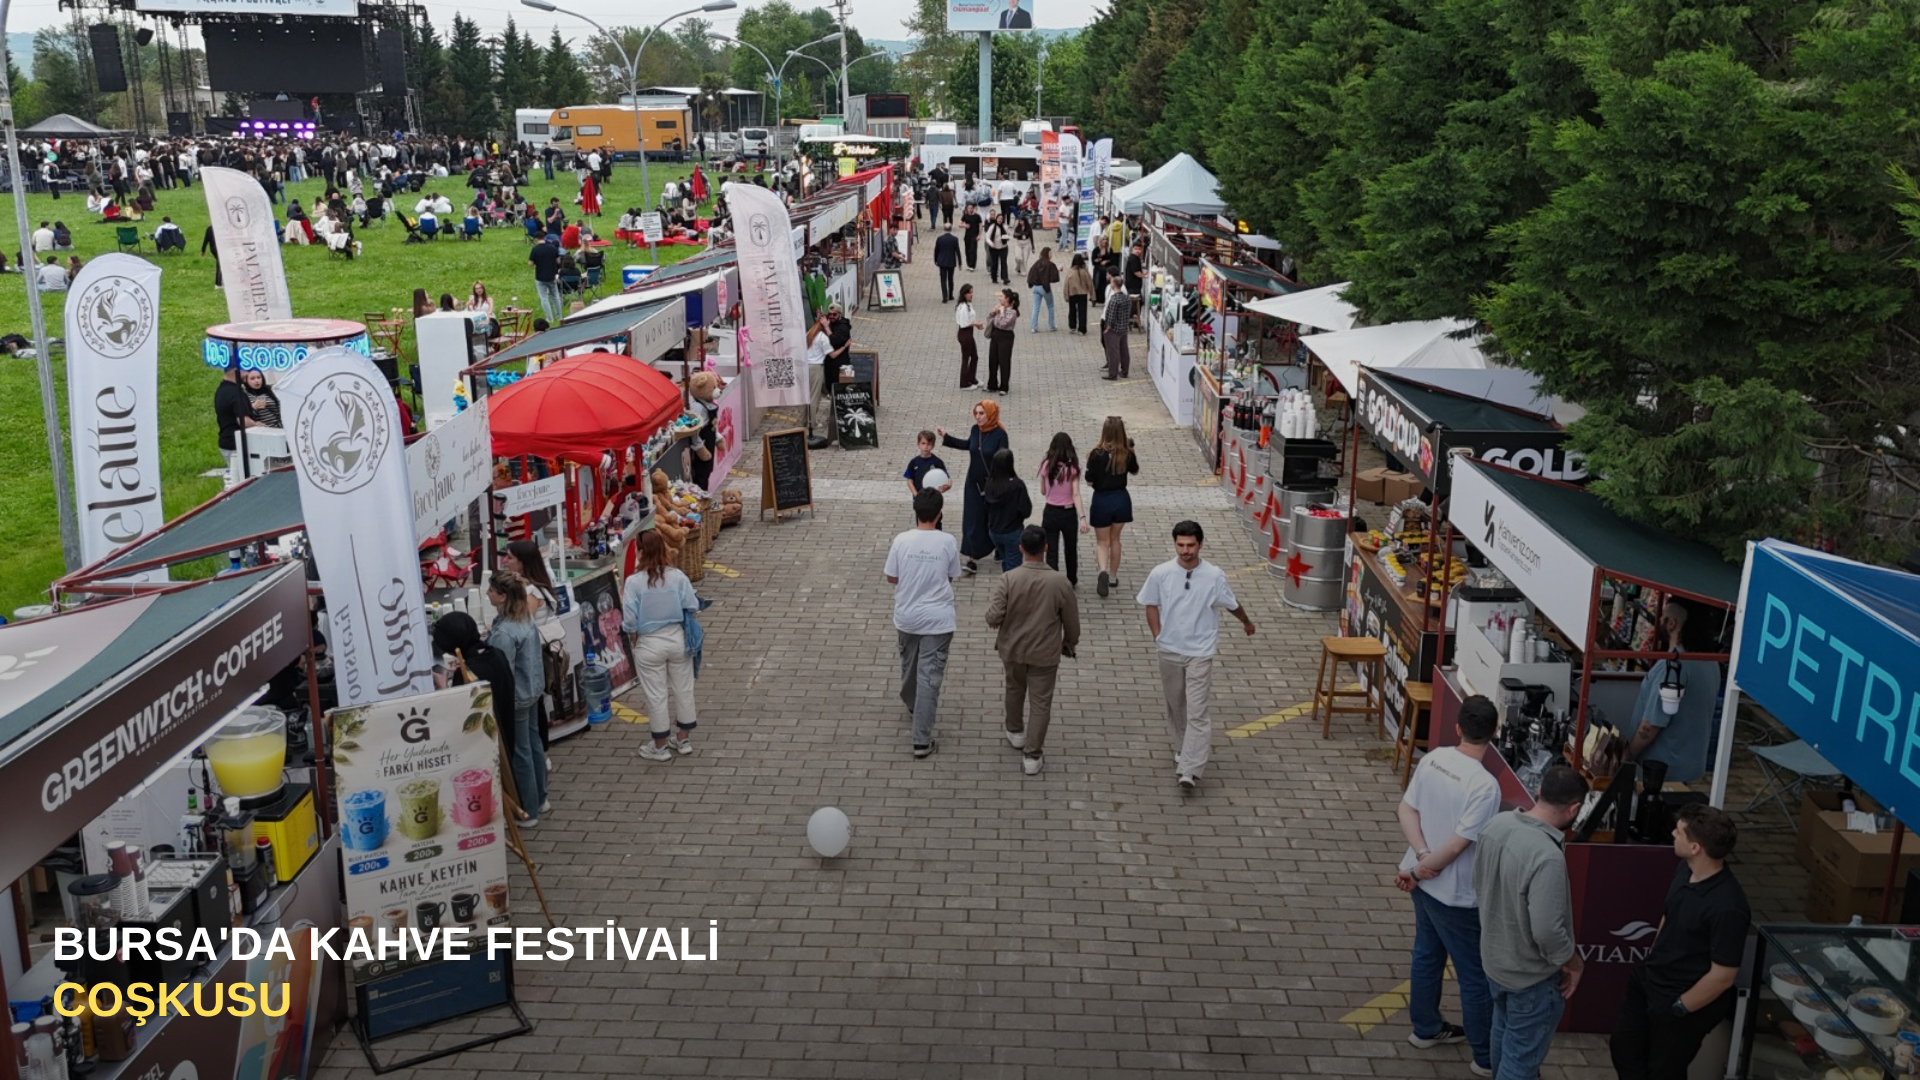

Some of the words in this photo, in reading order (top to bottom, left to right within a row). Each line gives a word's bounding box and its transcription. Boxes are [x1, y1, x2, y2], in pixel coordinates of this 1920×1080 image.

[762, 260, 785, 346] PALMIERA
[88, 385, 157, 546] elatte
[380, 749, 400, 766] Her
[403, 740, 452, 762] Yudumda
[383, 762, 414, 777] FARKI
[417, 754, 452, 771] HİSSET
[473, 827, 495, 836] MATCHA
[364, 850, 389, 860] MATCHA
[411, 840, 435, 849] MATCHA
[380, 872, 425, 895] KAHVE
[431, 860, 478, 883] KEYFİN
